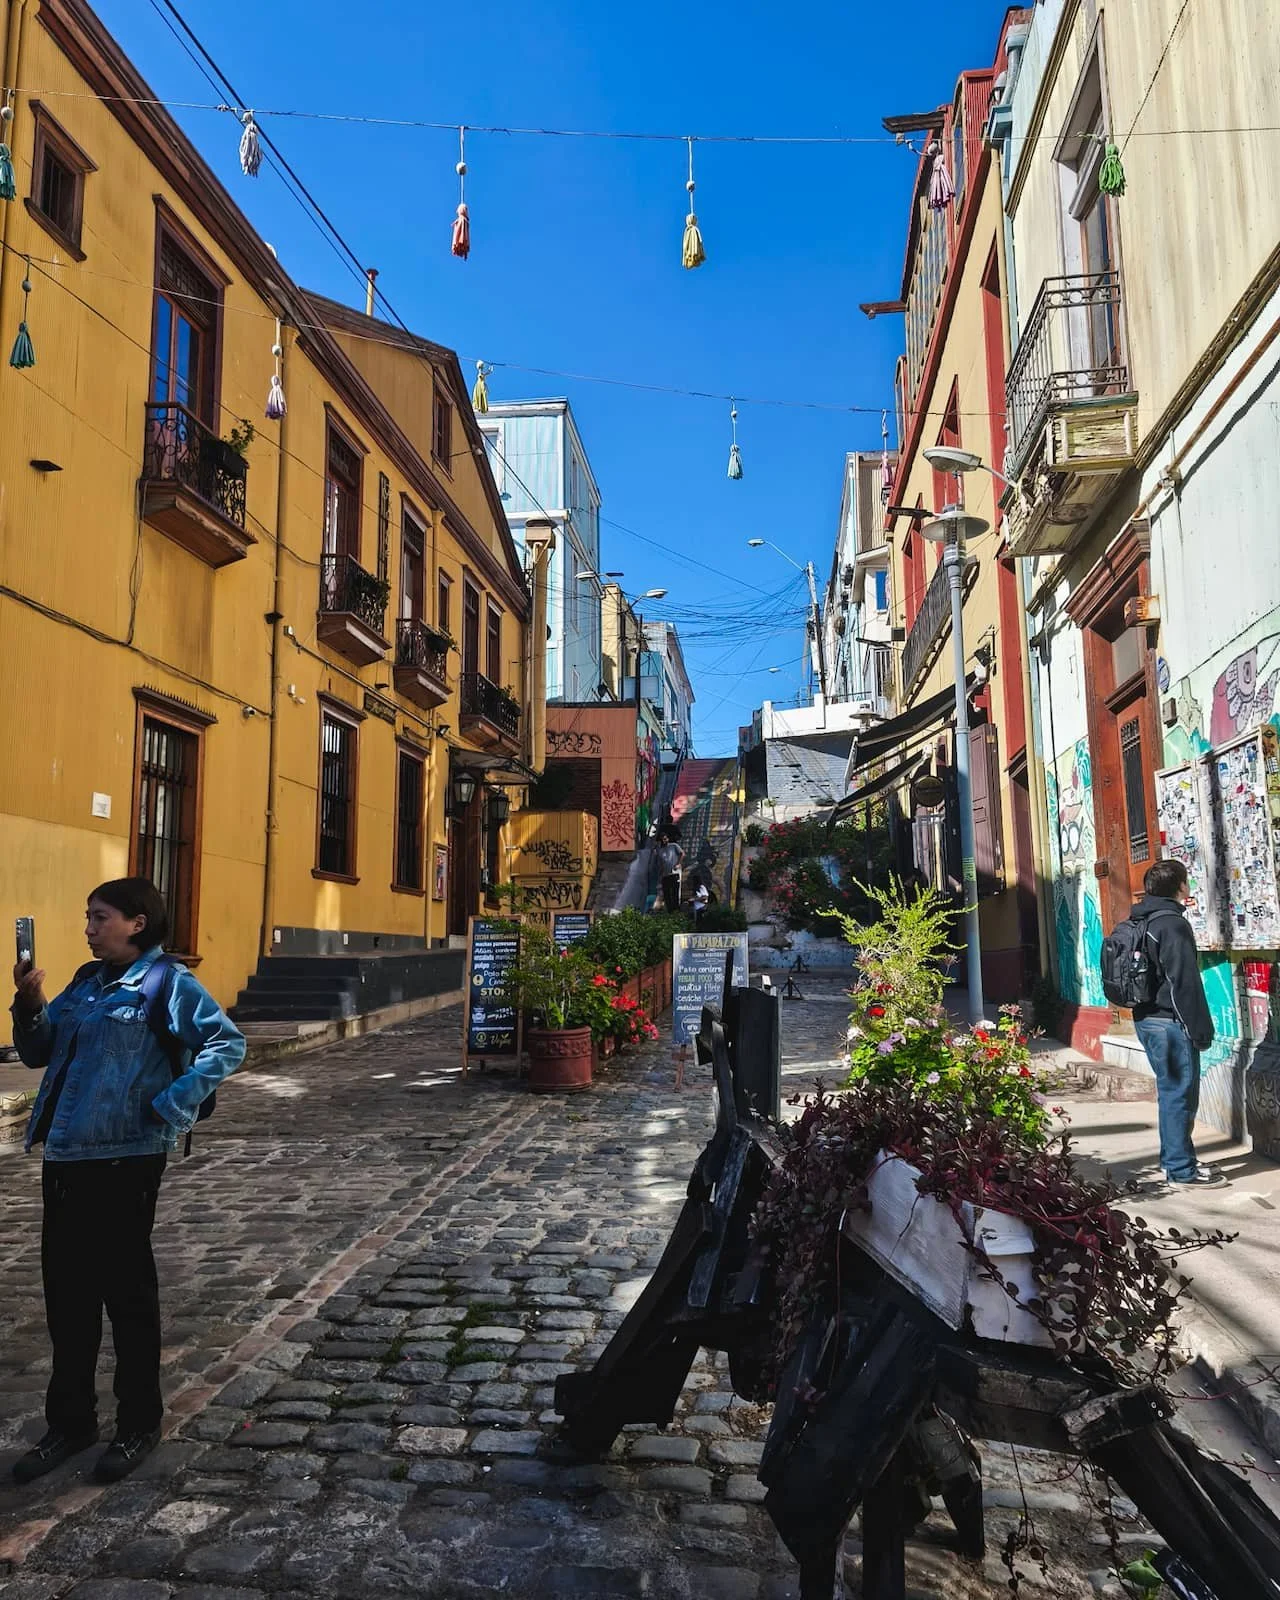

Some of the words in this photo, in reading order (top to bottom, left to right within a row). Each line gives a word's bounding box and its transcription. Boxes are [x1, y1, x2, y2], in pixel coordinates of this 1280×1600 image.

[691, 935, 741, 949] PAPARAZZO
[678, 965, 697, 974] Pato
[699, 964, 722, 974] cordero
